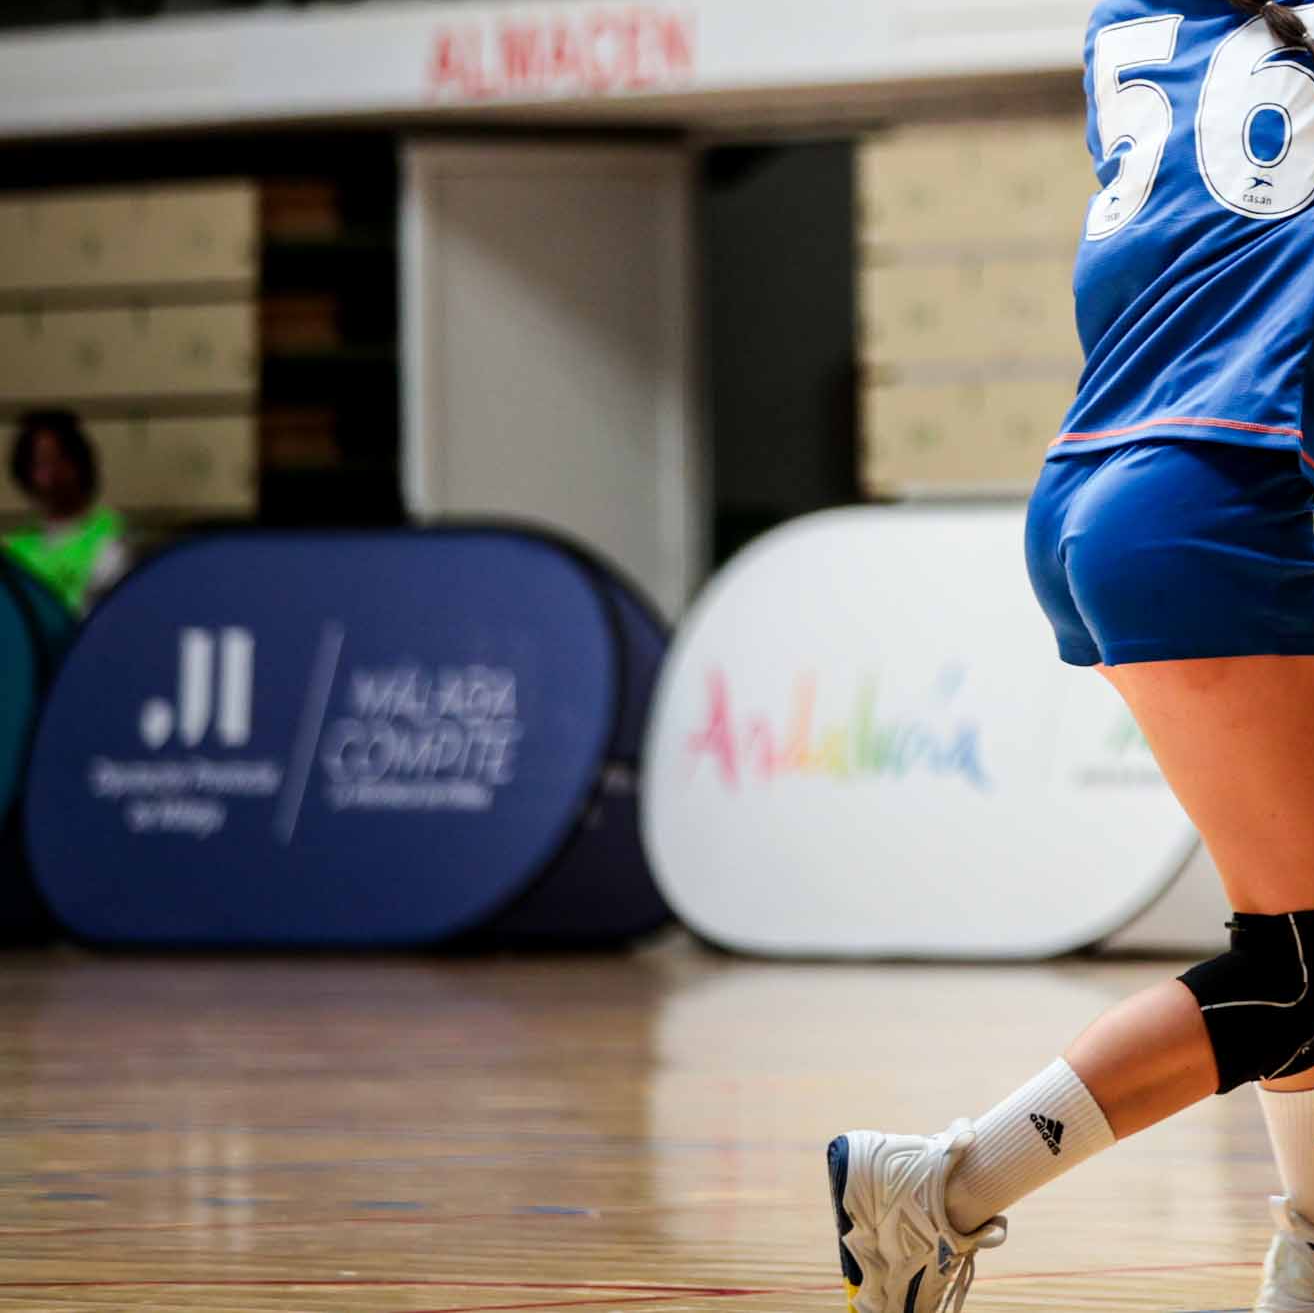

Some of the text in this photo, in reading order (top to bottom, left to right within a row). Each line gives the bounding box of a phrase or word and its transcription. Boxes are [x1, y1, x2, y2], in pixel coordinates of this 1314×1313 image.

[346, 662, 521, 719] MÁLAGA
[320, 717, 522, 785] COMPITE
[684, 661, 992, 794] Andalucía
[1029, 1112, 1061, 1157] adidas
